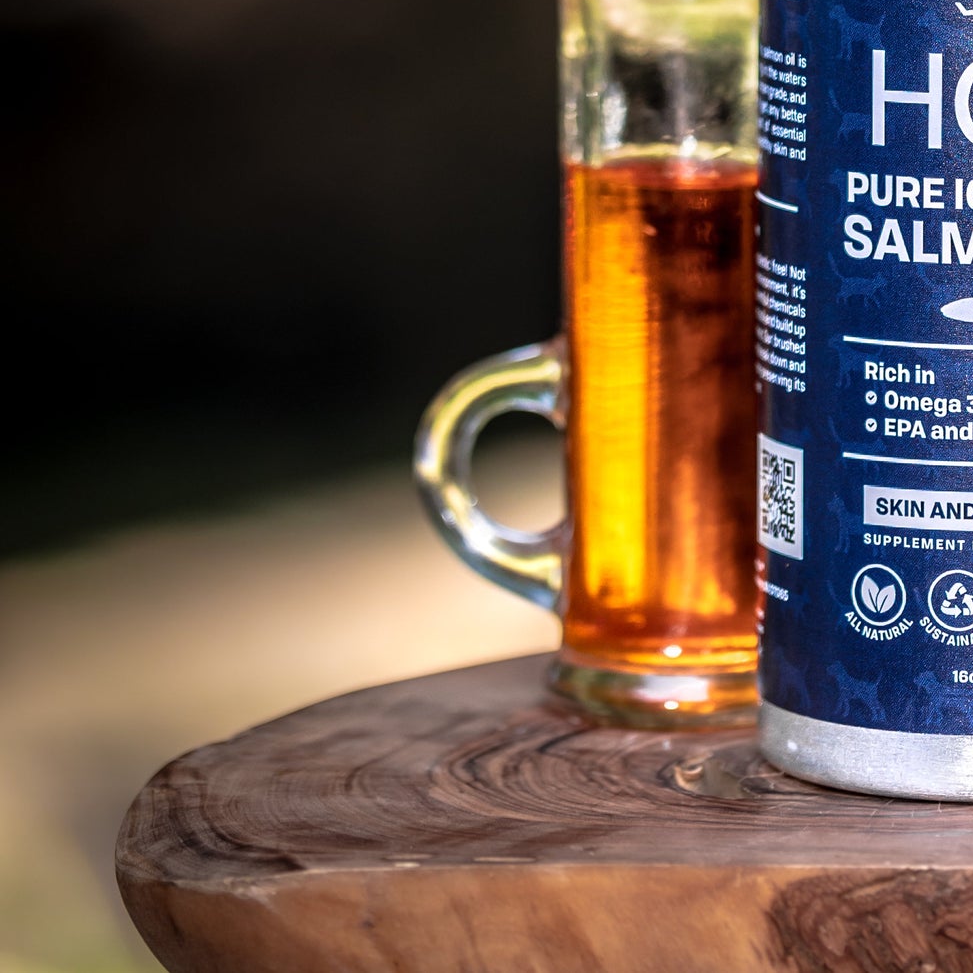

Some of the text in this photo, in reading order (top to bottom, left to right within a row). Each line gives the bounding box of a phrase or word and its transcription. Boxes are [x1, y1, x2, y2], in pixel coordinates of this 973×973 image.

[785, 52, 796, 67] oil
[798, 54, 807, 69] is
[779, 71, 807, 87] waters
[790, 92, 807, 106] and
[781, 106, 807, 124] better
[771, 124, 806, 142] essential
[790, 148, 807, 161] and
[847, 171, 945, 209] PURE
[789, 265, 806, 282] Not
[792, 284, 806, 300] it's
[769, 296, 806, 319] chemicals
[794, 325, 806, 340] up
[773, 334, 806, 355] brushed
[789, 360, 806, 374] and
[864, 360, 935, 385] Rich in
[794, 377, 806, 393] its
[884, 390, 962, 417] Omega
[884, 418, 926, 439] EPA
[930, 421, 973, 441] and
[875, 497, 924, 519] SKIN
[863, 533, 965, 551] SUPPLEMENT
[844, 610, 914, 642] ALL NATURAL
